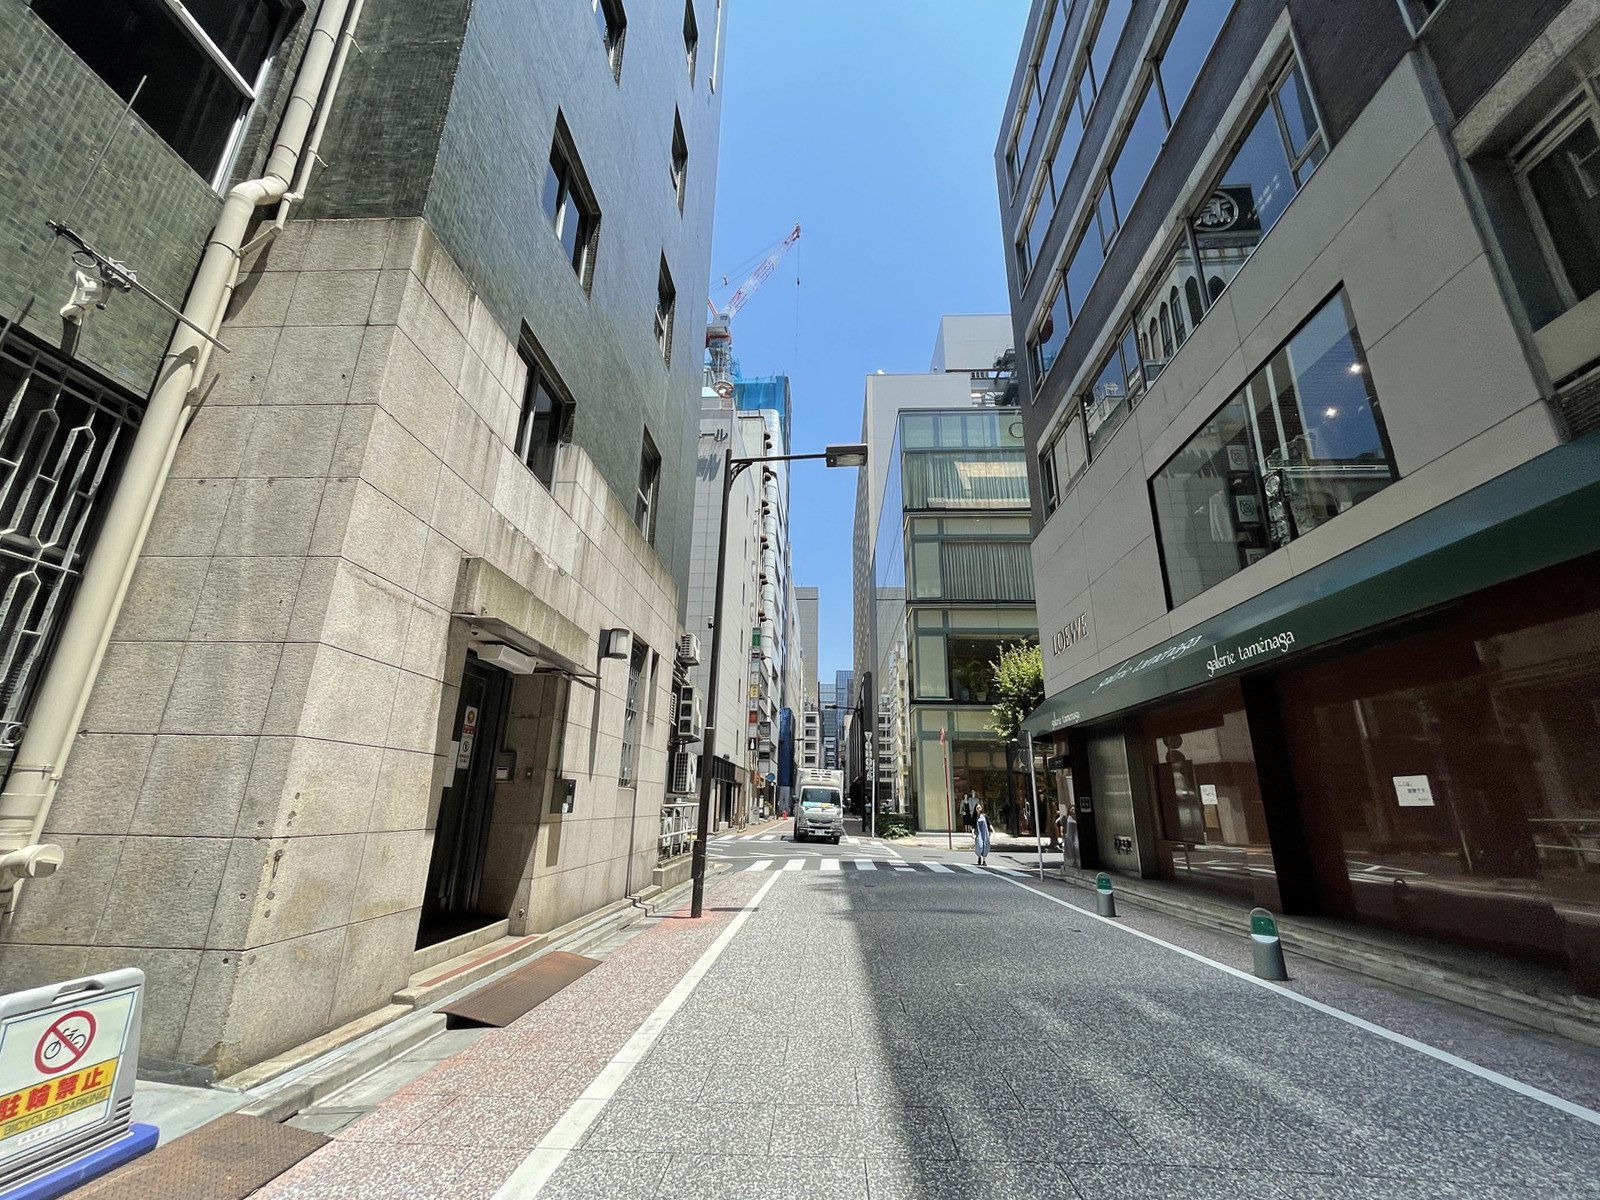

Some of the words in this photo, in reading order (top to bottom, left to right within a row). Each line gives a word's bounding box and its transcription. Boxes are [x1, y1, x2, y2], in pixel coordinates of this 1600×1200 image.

[1052, 611, 1089, 657] LOEWE
[1206, 644, 1236, 678] galerie
[0, 1066, 104, 1122] 駐輪禁止
[4, 1109, 60, 1136] BICYCLES
[60, 1089, 107, 1113] PARKING
